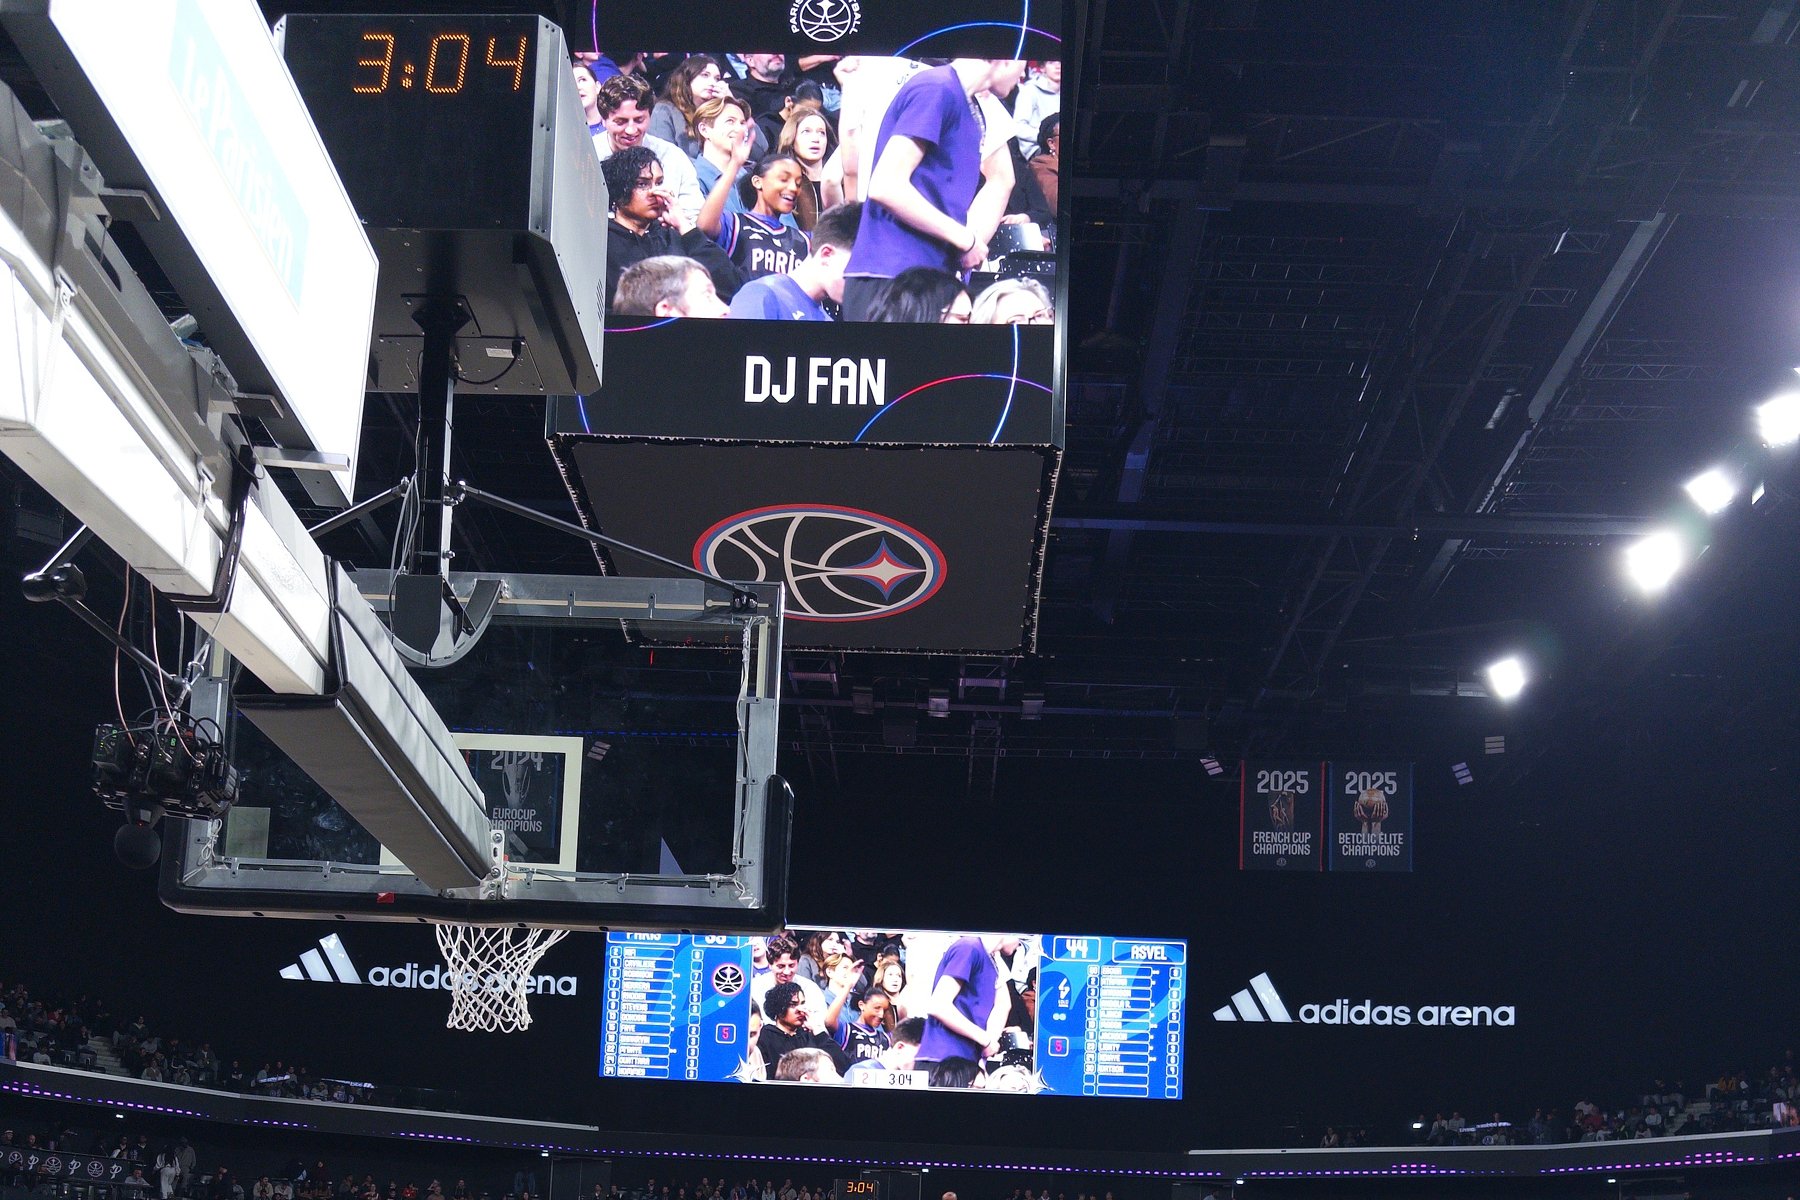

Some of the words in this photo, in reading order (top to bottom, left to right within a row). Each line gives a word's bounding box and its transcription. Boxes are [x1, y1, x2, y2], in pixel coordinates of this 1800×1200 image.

[353, 34, 527, 93] 3:04
[745, 356, 796, 403] DJ
[808, 357, 886, 405] FAN
[1257, 770, 1309, 794] 2025
[1345, 772, 1397, 795] 2025
[492, 807, 536, 820] EUROCUP
[490, 819, 543, 833] HAMPIONS
[1253, 832, 1290, 844] FRENCH
[1292, 832, 1311, 844] CUP
[1338, 832, 1377, 845] BETCLIC
[1253, 843, 1311, 856] CHAMPIONS
[1342, 844, 1400, 857] CHAMPIONS
[1066, 939, 1089, 959] 44
[1131, 945, 1168, 960] ASVEL
[1299, 998, 1411, 1026] adidas
[1417, 1005, 1515, 1027] arena
[722, 1027, 730, 1040] 5
[1054, 1040, 1063, 1052] 5
[888, 1073, 912, 1086] 3:04
[846, 1181, 874, 1194] 3:04
